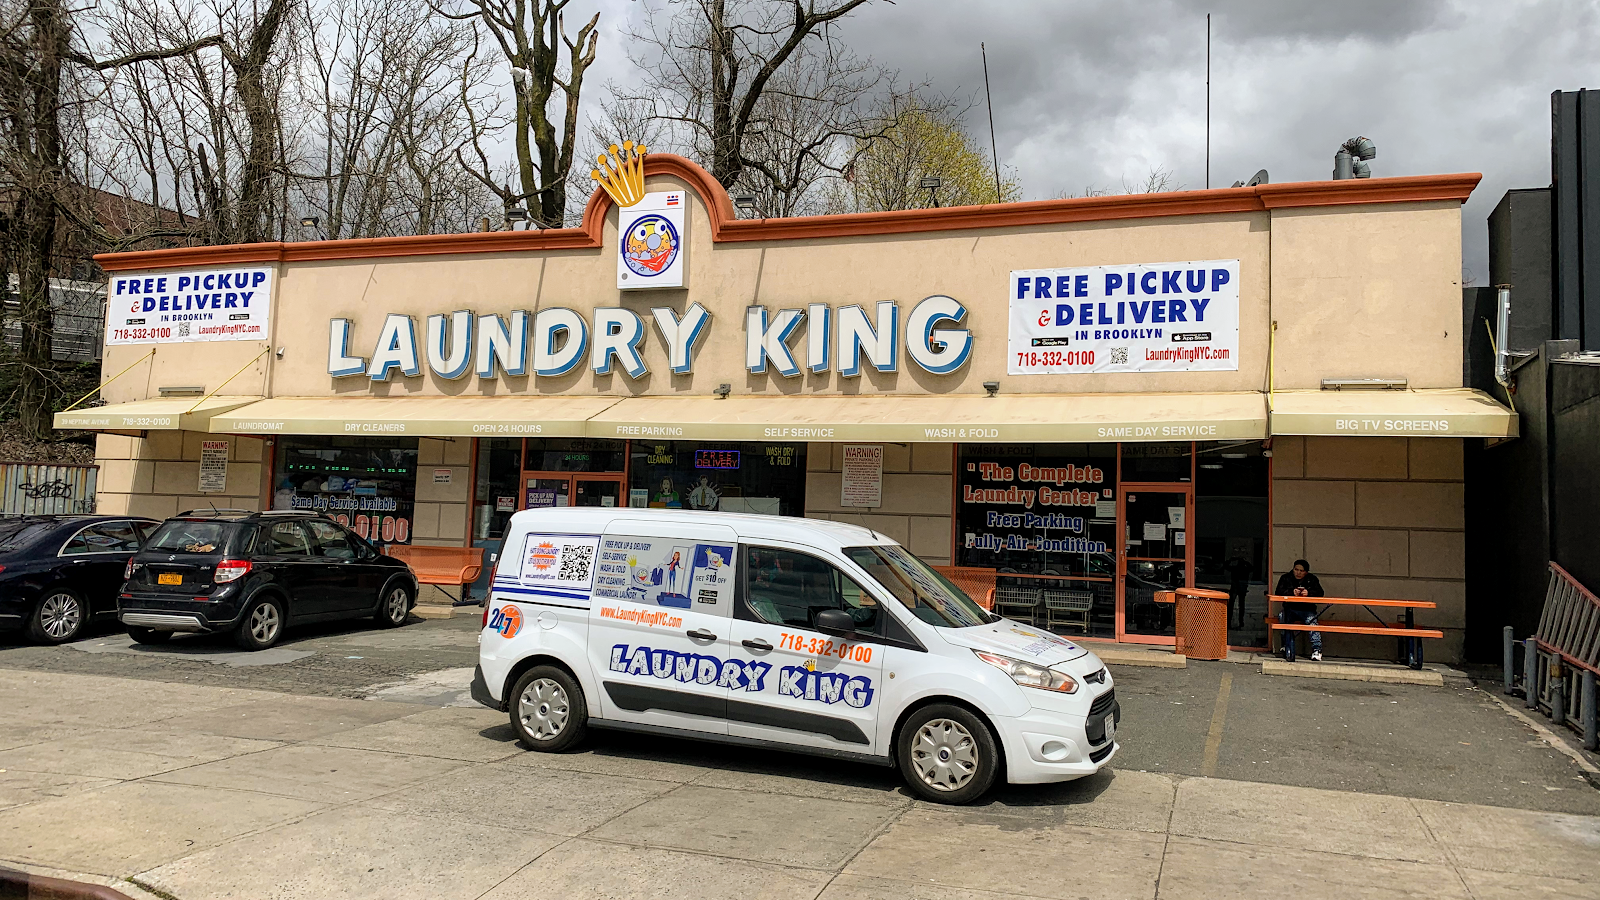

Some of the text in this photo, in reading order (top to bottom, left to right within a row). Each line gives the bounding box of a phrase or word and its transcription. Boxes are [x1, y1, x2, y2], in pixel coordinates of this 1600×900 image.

[116, 272, 266, 295] FREE PICKUP
[1017, 269, 1230, 299] FREE PICKUP
[131, 292, 254, 313] & DELIVERY
[172, 313, 213, 322] BROOKLYN
[1038, 299, 1211, 327] & DELIVERY
[114, 327, 171, 339] 718-332-0100
[198, 325, 260, 336] LaundryKingNYC.com
[1075, 328, 1163, 341] IN BROOKLYN
[327, 294, 974, 382] LAUNDRY KING
[1017, 350, 1095, 367] 718-332-0100
[1145, 347, 1230, 363] LaundryKingNYC.com
[122, 417, 171, 426] 718-332-0100
[233, 421, 284, 430] LAUNDROMAT
[1335, 419, 1449, 431] BIG TV SCREENS
[344, 423, 405, 432] DRY CLEANERS
[472, 424, 542, 433] OPEN 24 HOURS
[616, 425, 683, 436] FREE PARKING
[764, 428, 835, 438] SELF SERVICE
[924, 428, 999, 438] WASH & FOLD
[1097, 425, 1217, 438] SAME DAY SERVICE
[655, 445, 665, 455] DRY
[702, 451, 732, 459] FREE
[765, 446, 795, 456] WASH DRY
[845, 447, 882, 458] WARNING!
[647, 454, 673, 465] CLEANING
[696, 459, 738, 467] DELIVERY
[769, 456, 791, 466] & FOLD
[979, 462, 1014, 481] The
[1018, 462, 1103, 486] Complete
[963, 484, 1036, 509] Laundry
[1038, 486, 1099, 507] Center
[291, 494, 397, 511] Same Day Service Available
[986, 511, 1083, 533] Free Parking
[604, 540, 614, 548] FREE
[614, 541, 623, 549] PICK
[633, 543, 652, 551] DELIVERY
[1006, 534, 1029, 550] Air
[1035, 535, 1107, 554] Condition
[600, 564, 611, 572] WASH
[615, 565, 626, 573] FOLD
[597, 576, 626, 586] DRY CLEANING
[705, 574, 717, 583] $10
[600, 605, 682, 628] www.LaundryKingNYC.com
[779, 632, 873, 664] 718-332-0100
[609, 643, 874, 709] LAUNDRY KING
